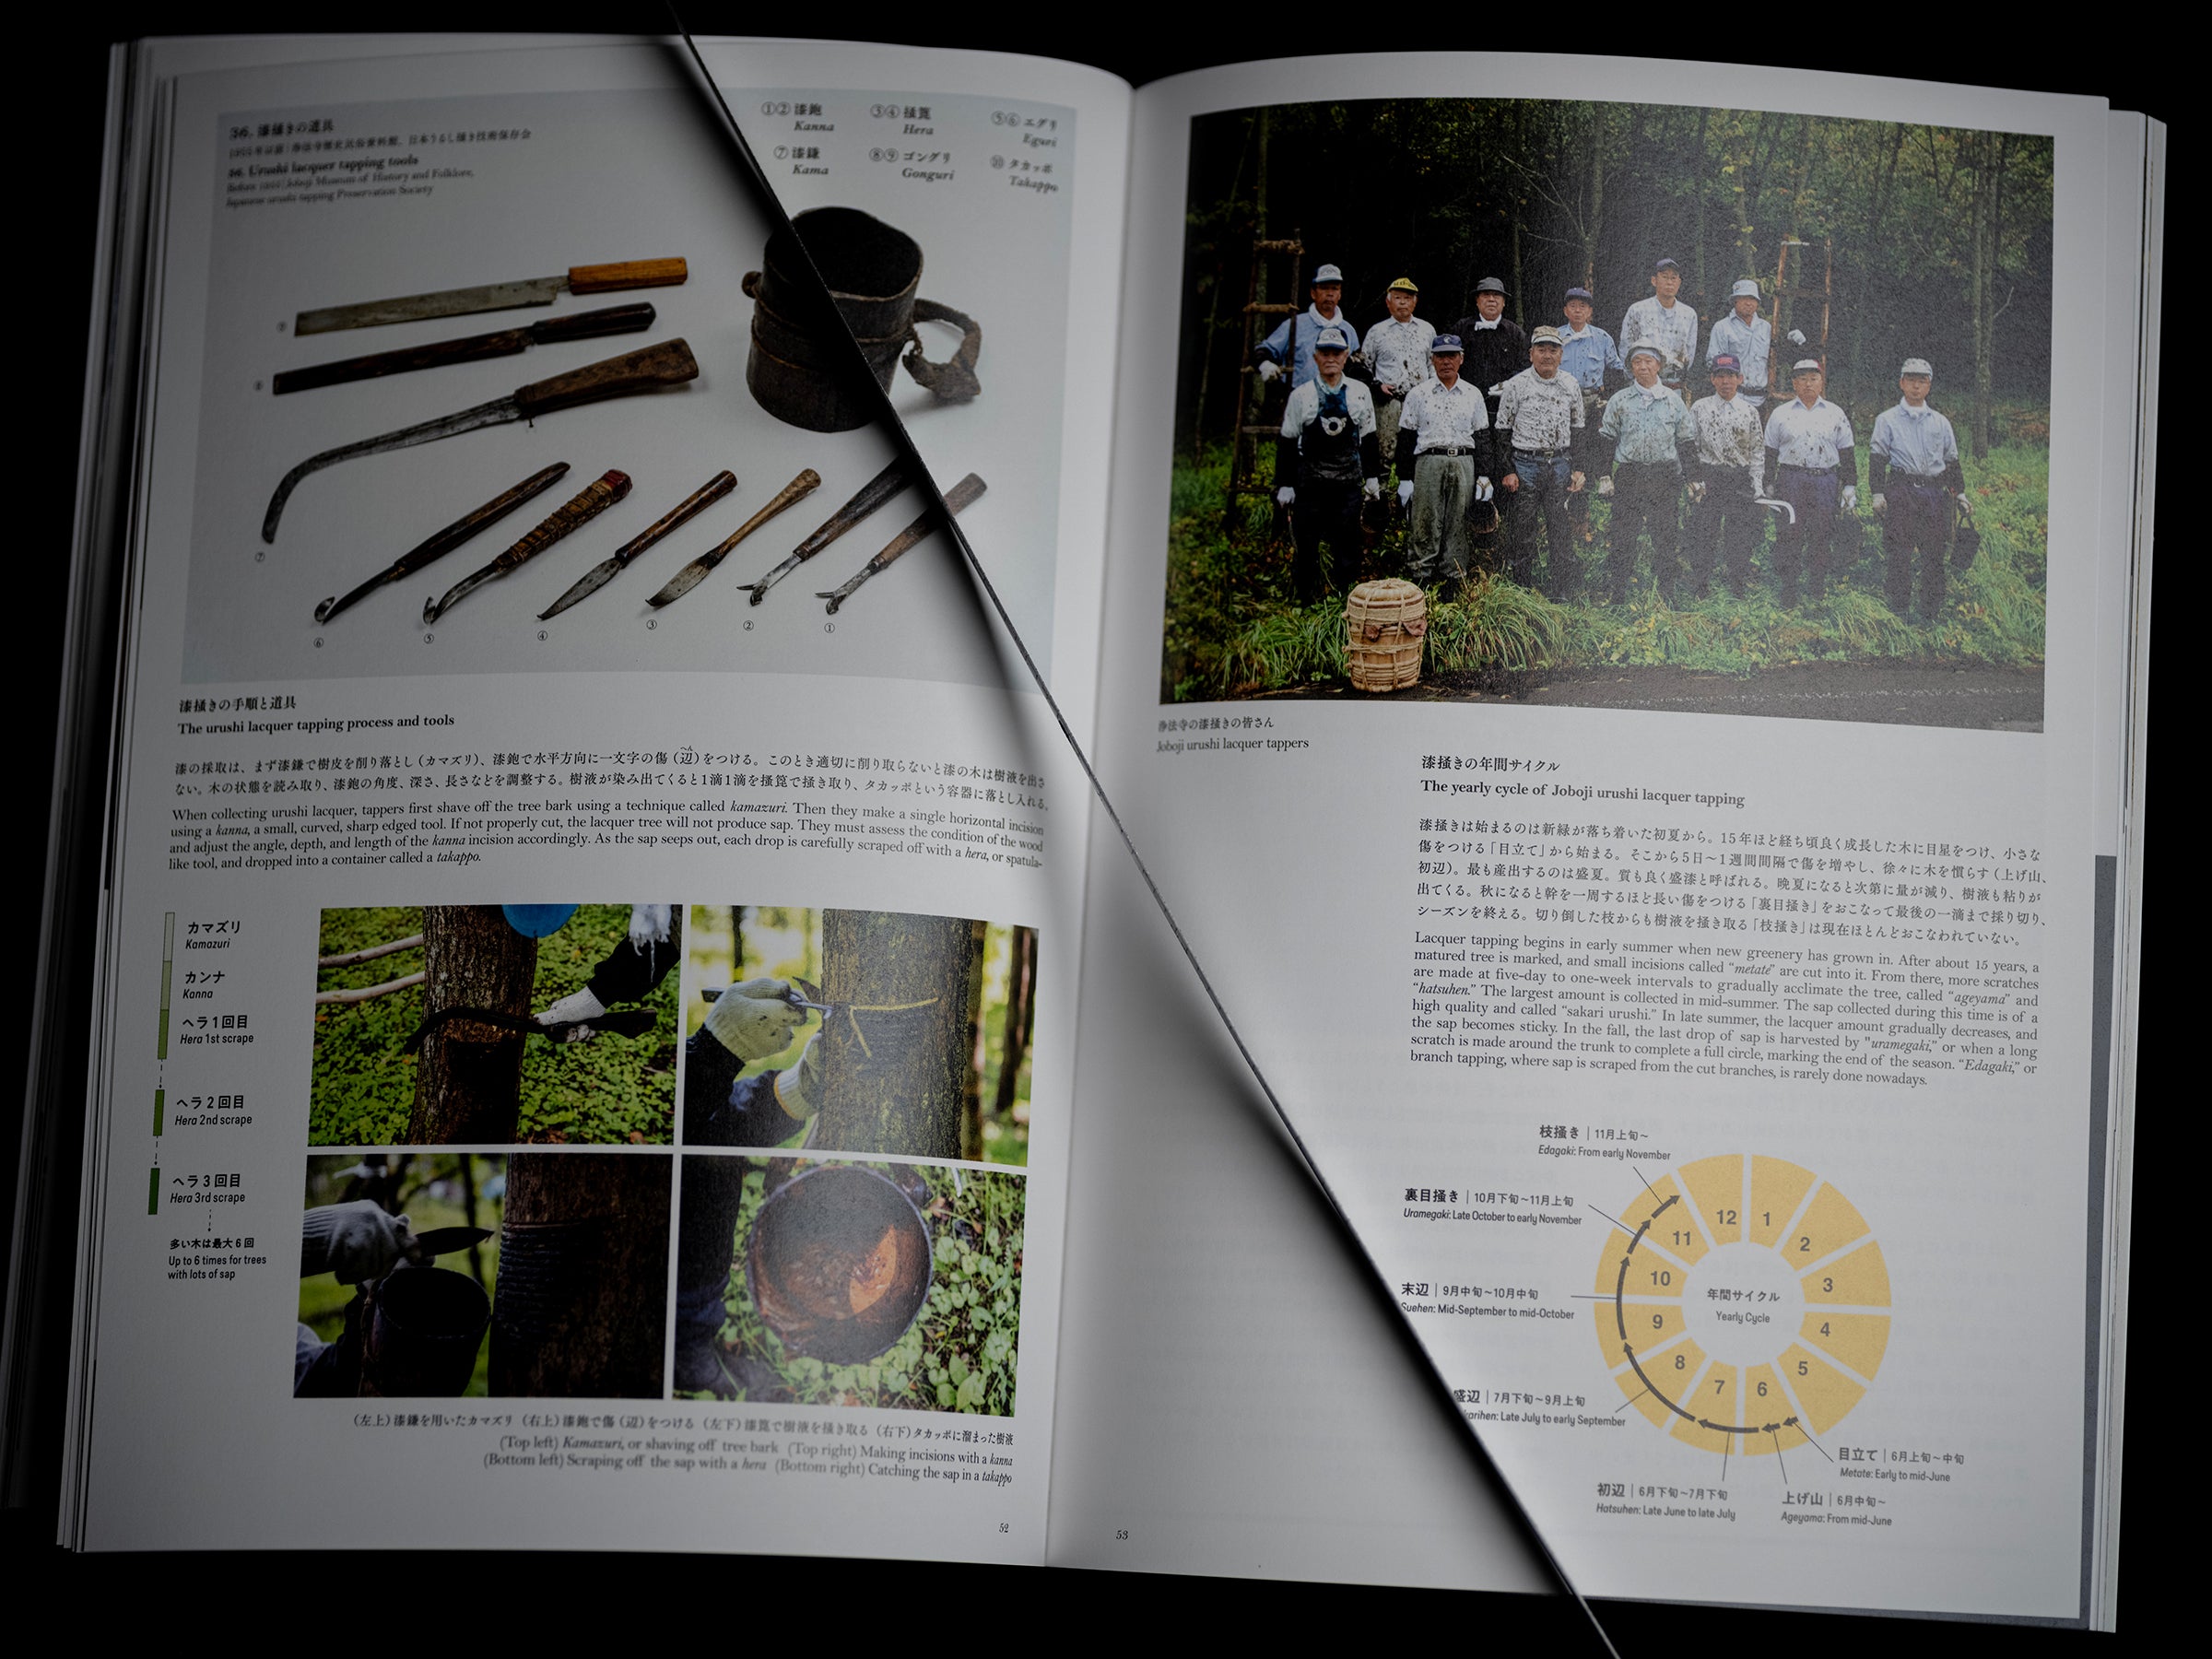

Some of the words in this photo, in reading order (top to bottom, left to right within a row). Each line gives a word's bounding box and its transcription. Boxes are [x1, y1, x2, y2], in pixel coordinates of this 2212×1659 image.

[793, 120, 835, 132] Kanna
[902, 124, 935, 135] Hera
[792, 163, 830, 176] Kama
[901, 167, 955, 182] Gonguri
[177, 722, 203, 735] The
[206, 720, 244, 734] urushi
[248, 720, 294, 735] lacquer
[297, 717, 345, 734] tapping
[347, 718, 394, 733] process
[396, 714, 419, 727] and
[423, 713, 455, 726] tools
[1157, 738, 1184, 755] Joboji
[1186, 737, 1220, 751] urushi
[1222, 736, 1264, 752] lacquer
[1266, 738, 1310, 752] tappers
[1419, 779, 1449, 793] The
[1450, 781, 1492, 797] yearly
[1494, 782, 1529, 798] cycle
[1532, 783, 1548, 796] of
[1551, 783, 1594, 802] Joboji
[1596, 787, 1639, 800] urushi
[1642, 788, 1692, 806] lacquer
[1694, 792, 1746, 809] tapping
[171, 808, 207, 821] When
[210, 806, 268, 822] collecting
[271, 805, 308, 818] urushi
[312, 805, 358, 819] lacquer,
[361, 806, 405, 818] tappers
[408, 801, 433, 814] first
[436, 801, 471, 814] shave
[474, 799, 493, 813] off
[494, 799, 514, 812] the
[517, 802, 542, 812] tree
[545, 798, 572, 812] bark
[577, 798, 611, 815] using
[626, 798, 686, 815] technique
[688, 799, 725, 812] called
[729, 799, 788, 814] kamazuri.
[184, 937, 231, 950] Kamazuri
[1415, 930, 1467, 947] Lacquer
[1470, 934, 1520, 951] tapping
[1524, 935, 1565, 952] begins
[1569, 936, 1582, 949] in
[1586, 938, 1618, 955] early
[1622, 943, 1674, 954] summer
[1677, 942, 1712, 956] when
[1716, 947, 1742, 957] new
[1746, 949, 1804, 964] greenery
[1807, 947, 1829, 961] has
[1832, 953, 1874, 967] grown
[1878, 952, 1894, 966] in.
[182, 988, 214, 1000] Kanna
[179, 1033, 204, 1045] Hera
[205, 1032, 220, 1044] 1st
[221, 1034, 254, 1046] scrape
[174, 1114, 198, 1126] Hera
[199, 1113, 218, 1125] 2nd
[219, 1115, 253, 1128] scrape
[1537, 1144, 1577, 1159] Edagaki:
[1578, 1146, 1601, 1158] From
[1602, 1147, 1625, 1161] early
[1625, 1148, 1672, 1160] November
[170, 1192, 194, 1204] Hera
[194, 1191, 212, 1204] 3rd
[212, 1194, 246, 1206] scrape
[1403, 1207, 1452, 1222] Uramegaki:
[1452, 1209, 1471, 1221] Late
[1471, 1210, 1506, 1222] October
[1506, 1212, 1516, 1223] to
[1516, 1212, 1538, 1227] early
[1538, 1213, 1583, 1226] November
[1716, 1209, 1737, 1226] 12
[1763, 1212, 1770, 1226] 1
[1672, 1230, 1691, 1246] 11
[1799, 1236, 1811, 1252] 2
[168, 1255, 182, 1269] Up
[182, 1255, 193, 1266] to
[194, 1255, 200, 1265] 6
[202, 1254, 228, 1265] times
[229, 1253, 242, 1265] for
[243, 1254, 267, 1265] trees
[167, 1268, 188, 1280] with
[189, 1268, 206, 1280] lots
[207, 1267, 218, 1279] of
[219, 1270, 236, 1281] sap
[1650, 1270, 1671, 1287] 10
[1822, 1277, 1833, 1293] 3
[1437, 1303, 1507, 1318] Mid-September
[1508, 1307, 1518, 1317] to
[1519, 1307, 1575, 1320] mid-October
[1715, 1310, 1744, 1325] Yearly
[1745, 1312, 1771, 1325] Cycle
[1652, 1313, 1664, 1330] 9
[1819, 1322, 1831, 1337] 4
[1675, 1354, 1686, 1371] 8
[1797, 1360, 1808, 1376] 5
[1714, 1379, 1725, 1394] 7
[1757, 1381, 1768, 1397] 6
[1500, 1410, 1521, 1422] Late
[1521, 1411, 1541, 1427] July
[1542, 1413, 1552, 1424] to
[1553, 1414, 1576, 1428] early
[1577, 1414, 1626, 1428] September
[860, 1444, 907, 1464] Making
[909, 1447, 956, 1463] incisions
[958, 1451, 980, 1465] with
[989, 1452, 1014, 1466] kanna
[1839, 1466, 1874, 1479] Metate:
[1875, 1468, 1898, 1483] Early
[1898, 1470, 1909, 1480] to
[1909, 1470, 1951, 1483] mid-June
[1595, 1502, 1641, 1515] Hatsuhen:
[1642, 1504, 1663, 1516] Late
[1663, 1505, 1687, 1517] June
[1687, 1507, 1698, 1518] to
[1698, 1507, 1715, 1519] late
[1715, 1508, 1736, 1523] July
[1780, 1511, 1826, 1525] Ageyama:
[1826, 1512, 1850, 1524] From
[1850, 1514, 1893, 1526] mid-June
[998, 1522, 1009, 1534] 52
[1115, 1529, 1129, 1541] 53
